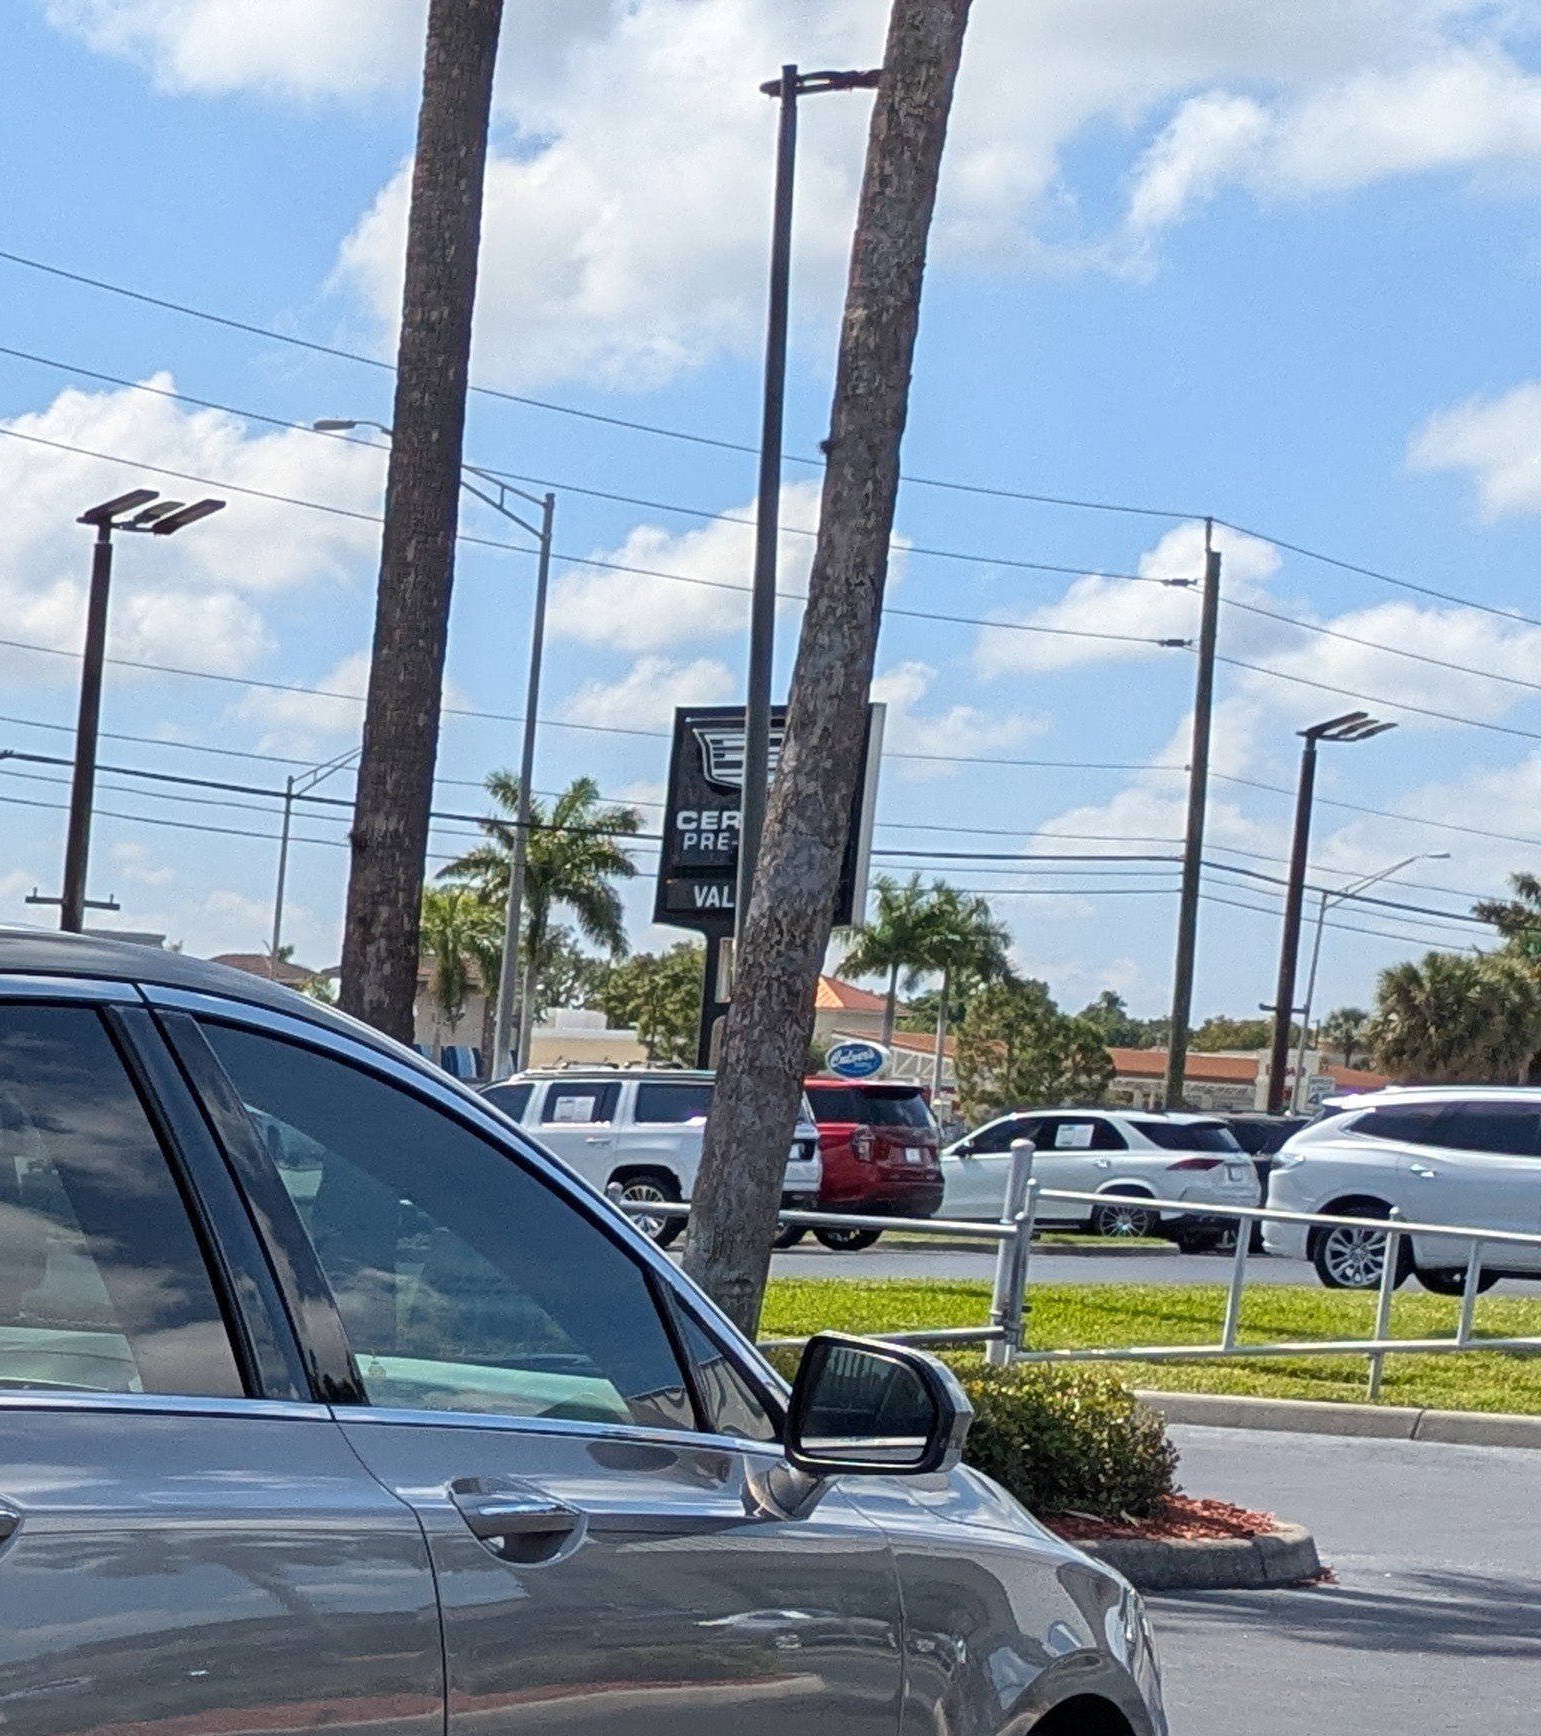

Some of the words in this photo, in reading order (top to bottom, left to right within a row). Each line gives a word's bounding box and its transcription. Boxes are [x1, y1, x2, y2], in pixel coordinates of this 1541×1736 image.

[677, 810, 744, 830] CER
[683, 832, 738, 850] PRE-
[694, 885, 735, 908] VAL
